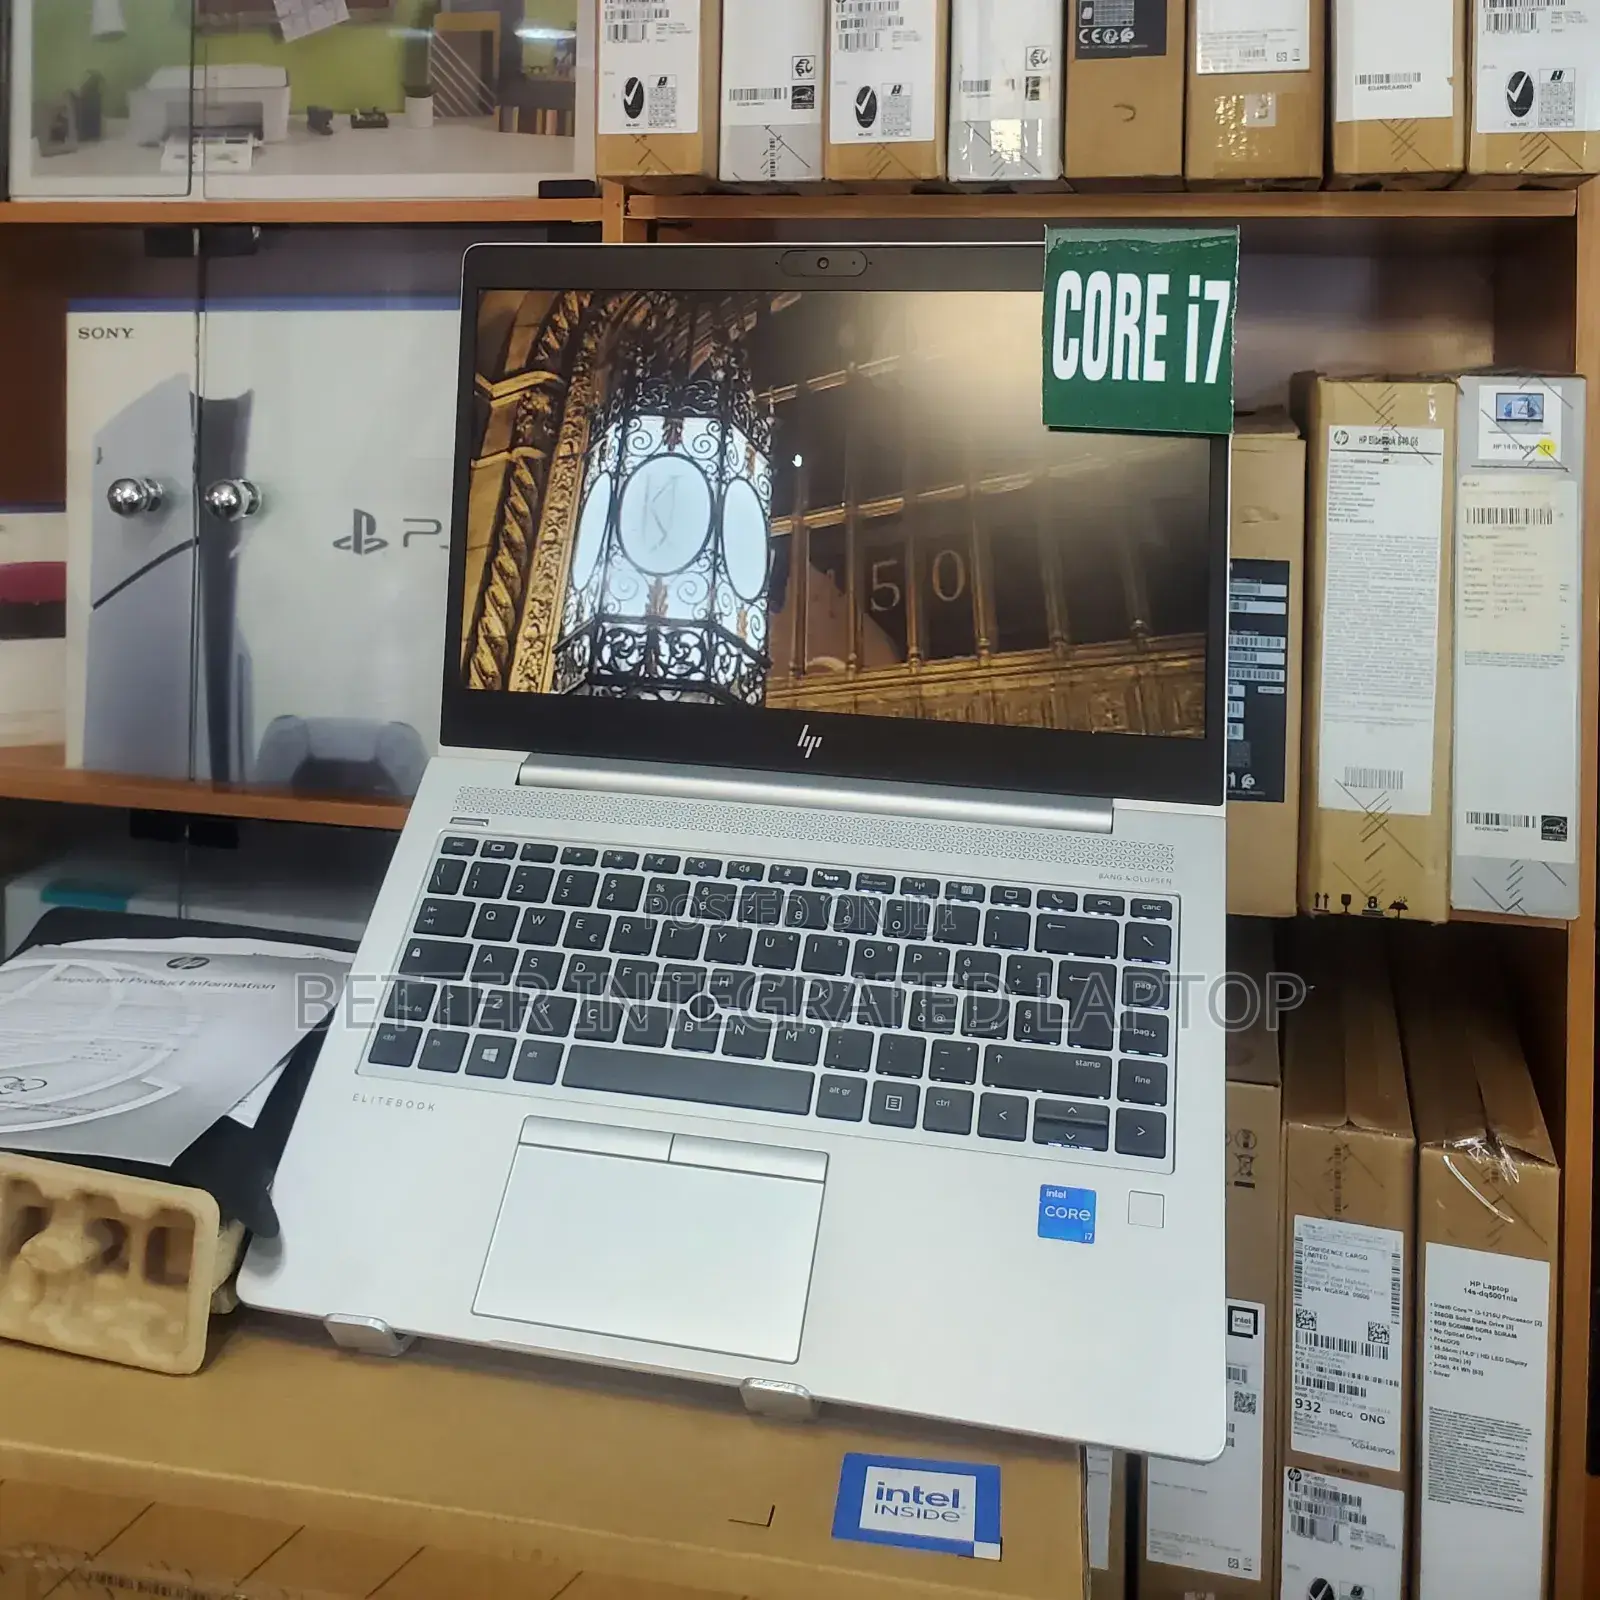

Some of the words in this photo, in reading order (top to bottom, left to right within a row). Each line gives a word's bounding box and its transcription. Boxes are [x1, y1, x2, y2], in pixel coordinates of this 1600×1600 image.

[1051, 270, 1170, 382] CORE
[1184, 274, 1232, 384] i7
[78, 327, 134, 340] SONY
[870, 560, 900, 612] 5
[931, 550, 966, 602] 0
[566, 875, 574, 884] £
[1098, 873, 1122, 881] BANG
[516, 884, 525, 893] 2
[610, 879, 617, 889] $
[656, 884, 665, 893] %
[561, 889, 569, 898] 3
[702, 887, 710, 896] &
[606, 893, 614, 902] 4
[653, 898, 660, 906] 5
[700, 902, 707, 911] 6
[747, 906, 754, 915] 7
[485, 910, 497, 921] Q
[532, 914, 546, 925] W
[795, 910, 803, 919] 8
[844, 915, 851, 924] 9
[575, 918, 586, 929] E
[621, 923, 632, 934] R
[669, 928, 678, 938] T
[717, 932, 727, 943] Y
[764, 937, 775, 948] U
[483, 953, 493, 963] A
[529, 958, 538, 968] S
[913, 953, 923, 963] P
[576, 962, 586, 973] D
[622, 967, 632, 977] F
[672, 972, 682, 982] G
[719, 977, 729, 987] H
[53, 976, 126, 985] Important
[129, 976, 185, 987] Product
[188, 979, 276, 991] Information
[768, 983, 776, 993] J
[818, 988, 828, 999] K
[492, 999, 504, 1009] Z
[869, 994, 877, 1004] L
[539, 1003, 550, 1014] X
[588, 1009, 598, 1020] C
[637, 1014, 647, 1024] V
[934, 1013, 945, 1023] @
[684, 1022, 694, 1032] B
[734, 1025, 746, 1035] N
[785, 1031, 798, 1042] M
[432, 1039, 441, 1047] fn
[1075, 1059, 1101, 1069] stamp
[1134, 1075, 1151, 1085] fine
[829, 1086, 840, 1094] alt
[841, 1088, 851, 1097] gr
[352, 1093, 436, 1111] ELITEBOOK
[936, 1099, 950, 1107] ctrl
[1046, 1188, 1067, 1199] intel
[1084, 1232, 1093, 1241] i7
[1303, 1252, 1328, 1260] LIMITED
[1304, 1244, 1343, 1257] CONFIDENCE
[1345, 1251, 1368, 1261] CARGO
[1324, 1286, 1350, 1297] NIGERIA
[1469, 1280, 1481, 1288] HP
[1483, 1281, 1510, 1294] Laptop
[1234, 1315, 1252, 1326] intel
[1488, 1320, 1504, 1329] Drive
[1443, 1329, 1465, 1339] Optical
[1466, 1333, 1482, 1342] Drive
[1294, 1398, 1321, 1413] 932
[1360, 1412, 1386, 1425] ONG
[1288, 1468, 1302, 1482] hp
[875, 1481, 960, 1509] intel
